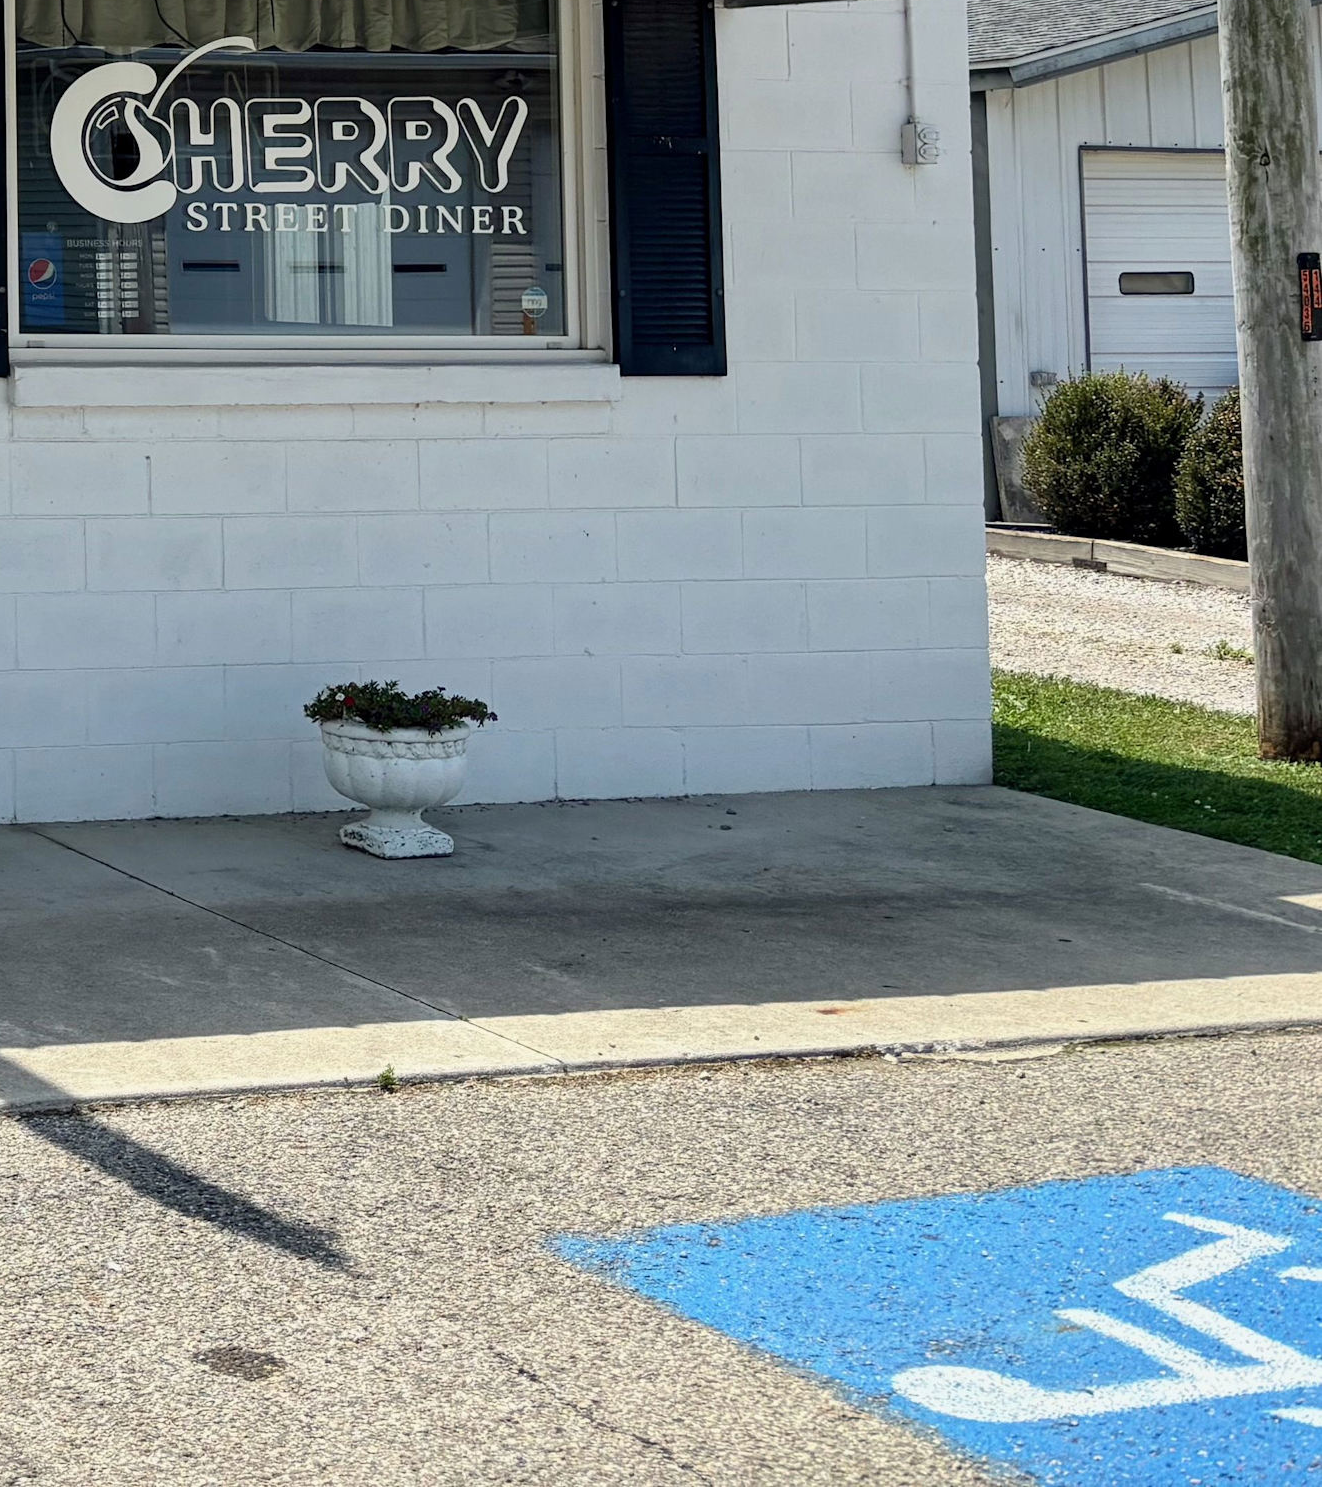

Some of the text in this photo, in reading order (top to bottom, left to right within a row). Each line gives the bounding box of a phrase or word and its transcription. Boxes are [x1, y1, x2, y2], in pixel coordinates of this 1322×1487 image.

[50, 61, 528, 224] CHERRY
[186, 202, 527, 235] STREET DINER
[66, 239, 143, 248] BUSINESS HOURS
